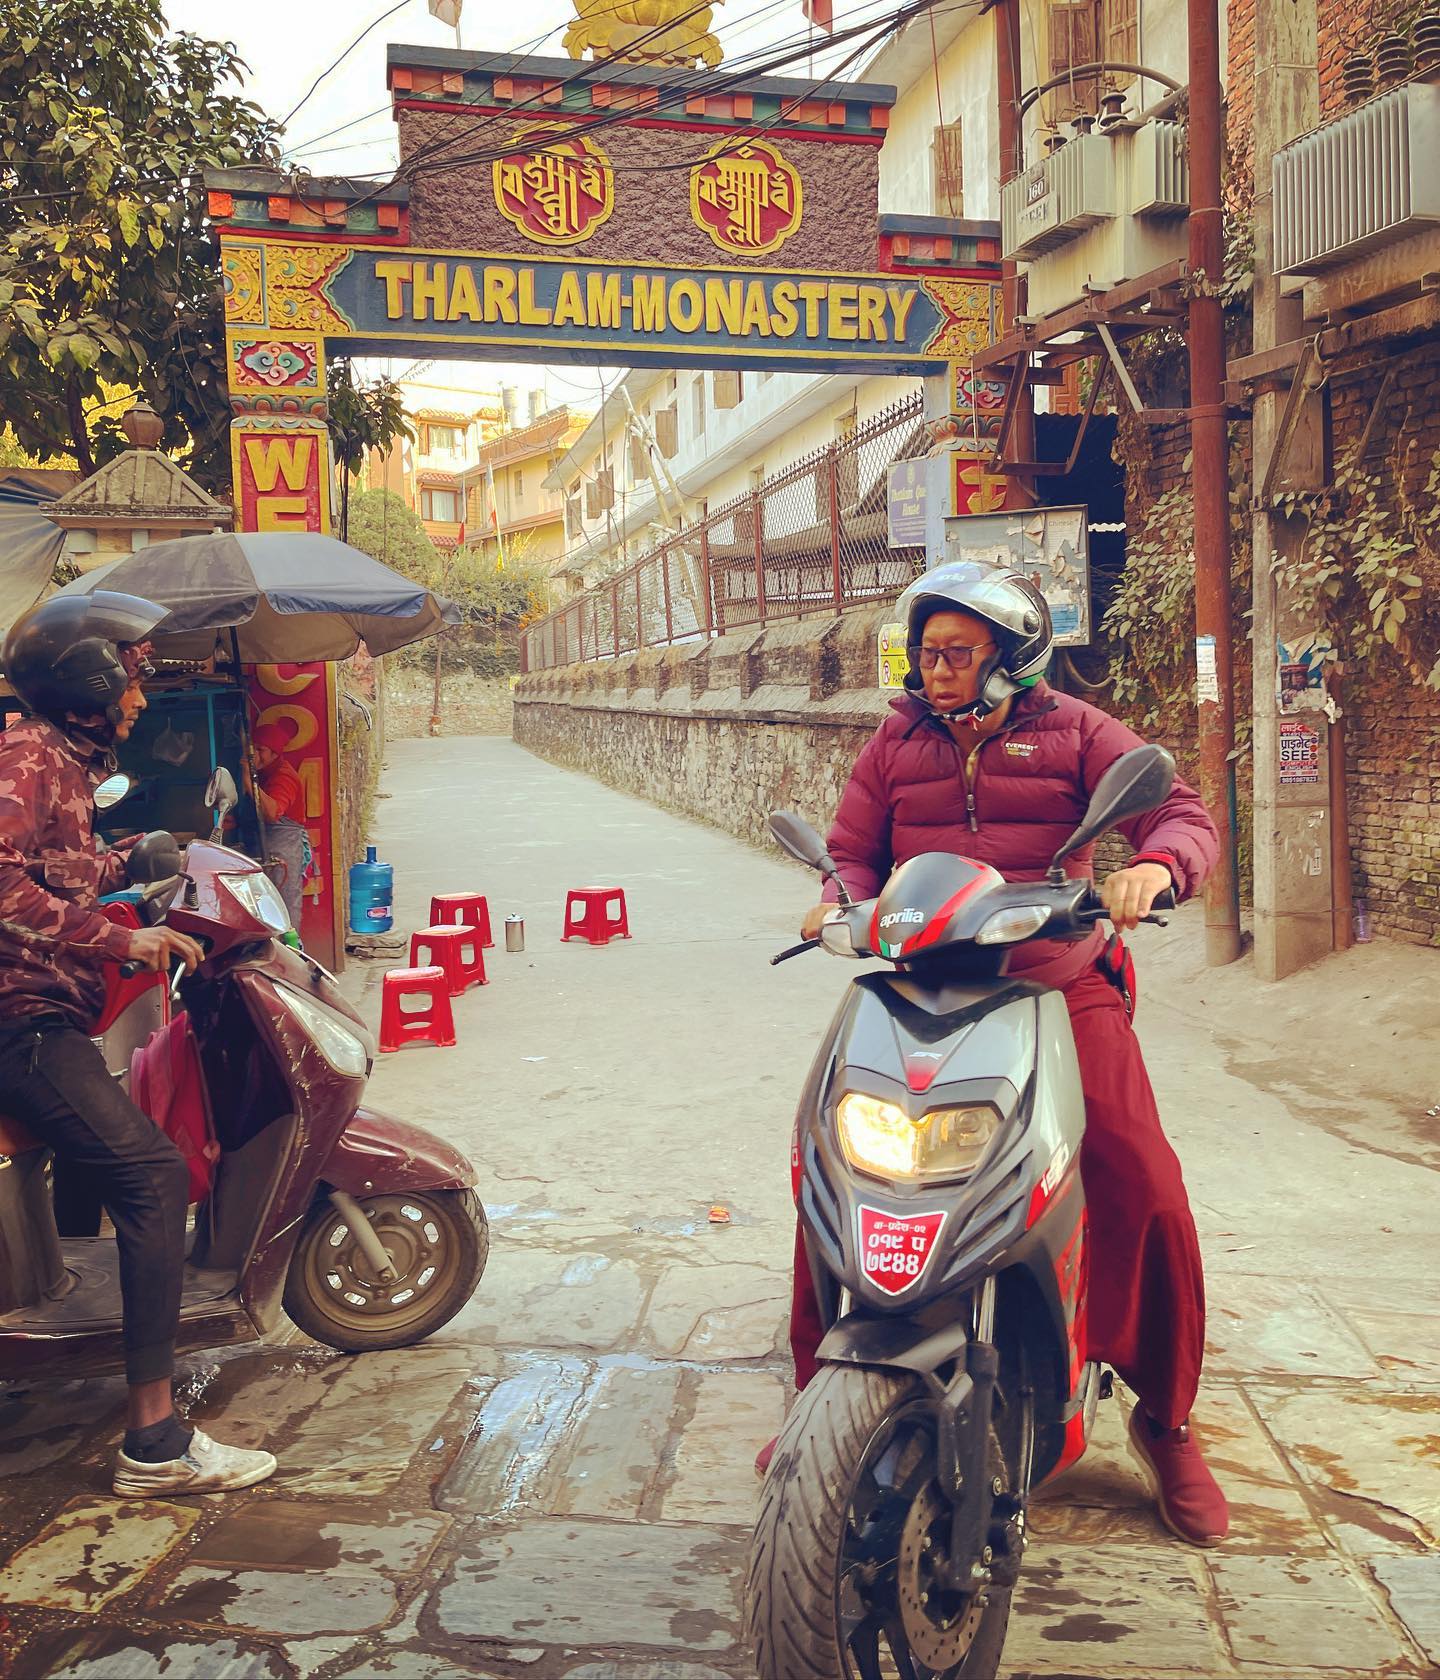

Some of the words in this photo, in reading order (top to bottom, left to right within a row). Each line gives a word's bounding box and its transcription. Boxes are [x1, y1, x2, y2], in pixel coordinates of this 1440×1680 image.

[1028, 181, 1044, 202] 160
[374, 260, 917, 343] THARLAM-MONASTERY
[1281, 750, 1309, 761] SEE
[880, 908, 924, 928] aprilia
